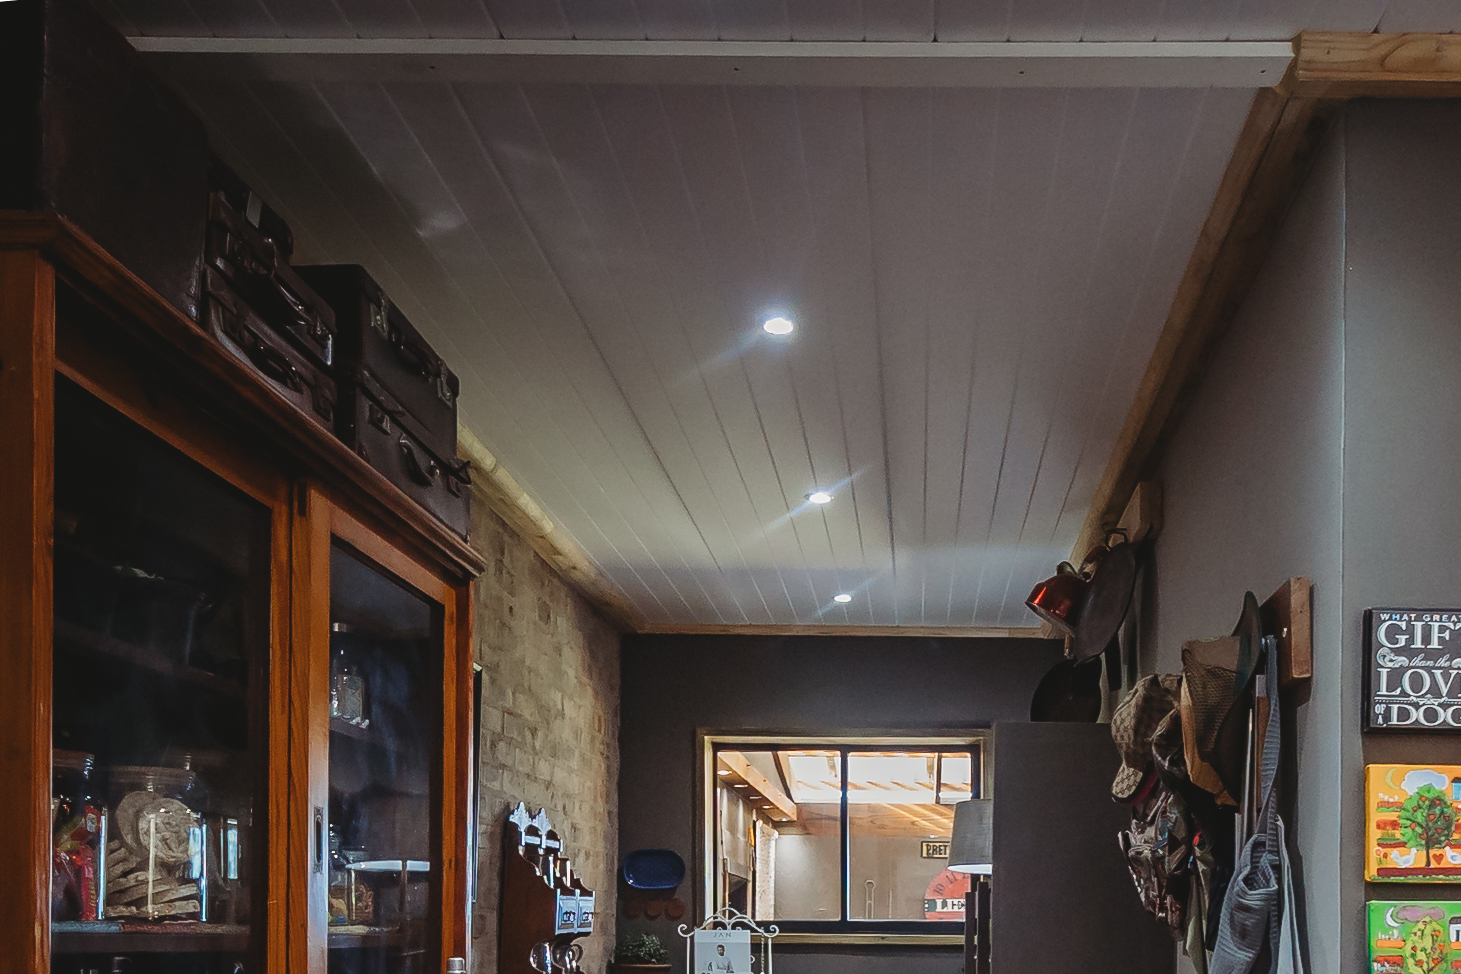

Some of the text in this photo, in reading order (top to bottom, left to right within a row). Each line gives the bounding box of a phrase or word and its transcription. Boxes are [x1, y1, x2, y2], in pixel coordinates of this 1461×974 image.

[1380, 613, 1416, 621] WHAT
[1410, 653, 1451, 667] than the
[1374, 704, 1387, 714] OF
[1377, 715, 1383, 724] A
